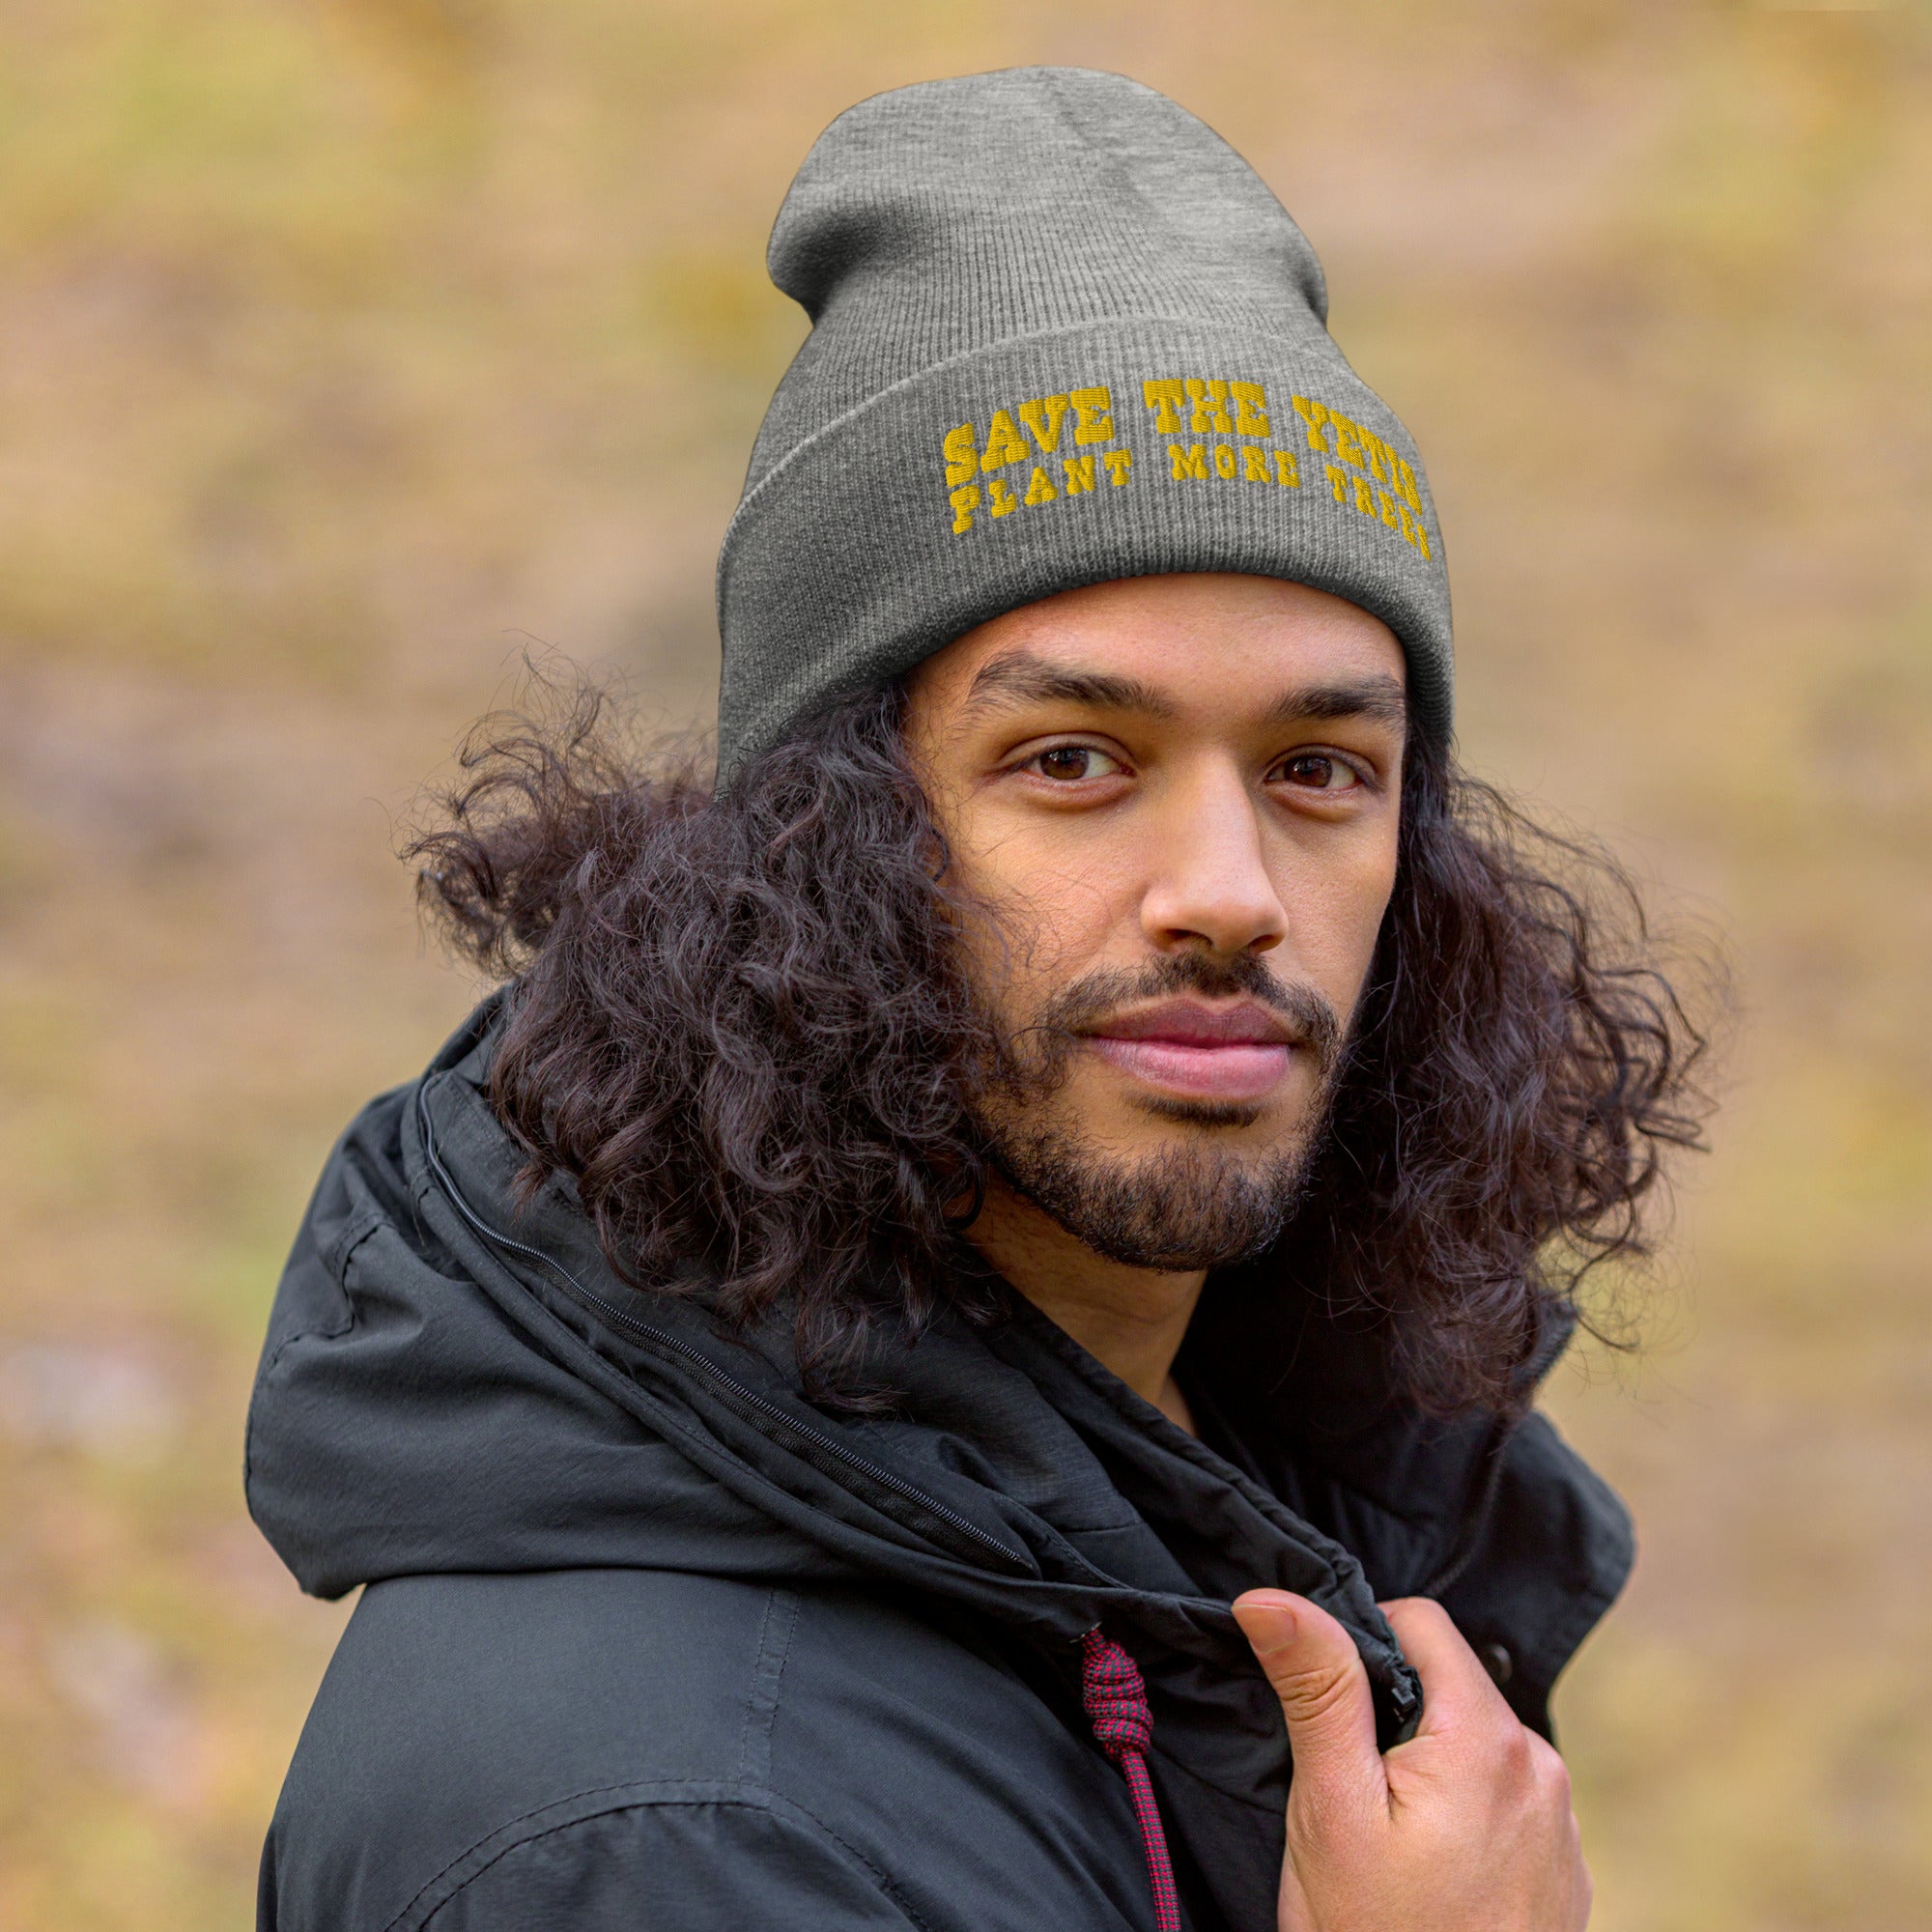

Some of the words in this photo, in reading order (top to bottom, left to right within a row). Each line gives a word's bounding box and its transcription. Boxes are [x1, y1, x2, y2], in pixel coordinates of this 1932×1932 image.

[942, 386, 1116, 489] SAVE
[1143, 378, 1271, 439] THE
[1292, 394, 1423, 517] YETIS
[949, 448, 1133, 536] PLANT
[1167, 443, 1300, 488] MORE
[1324, 464, 1432, 562] TREES
